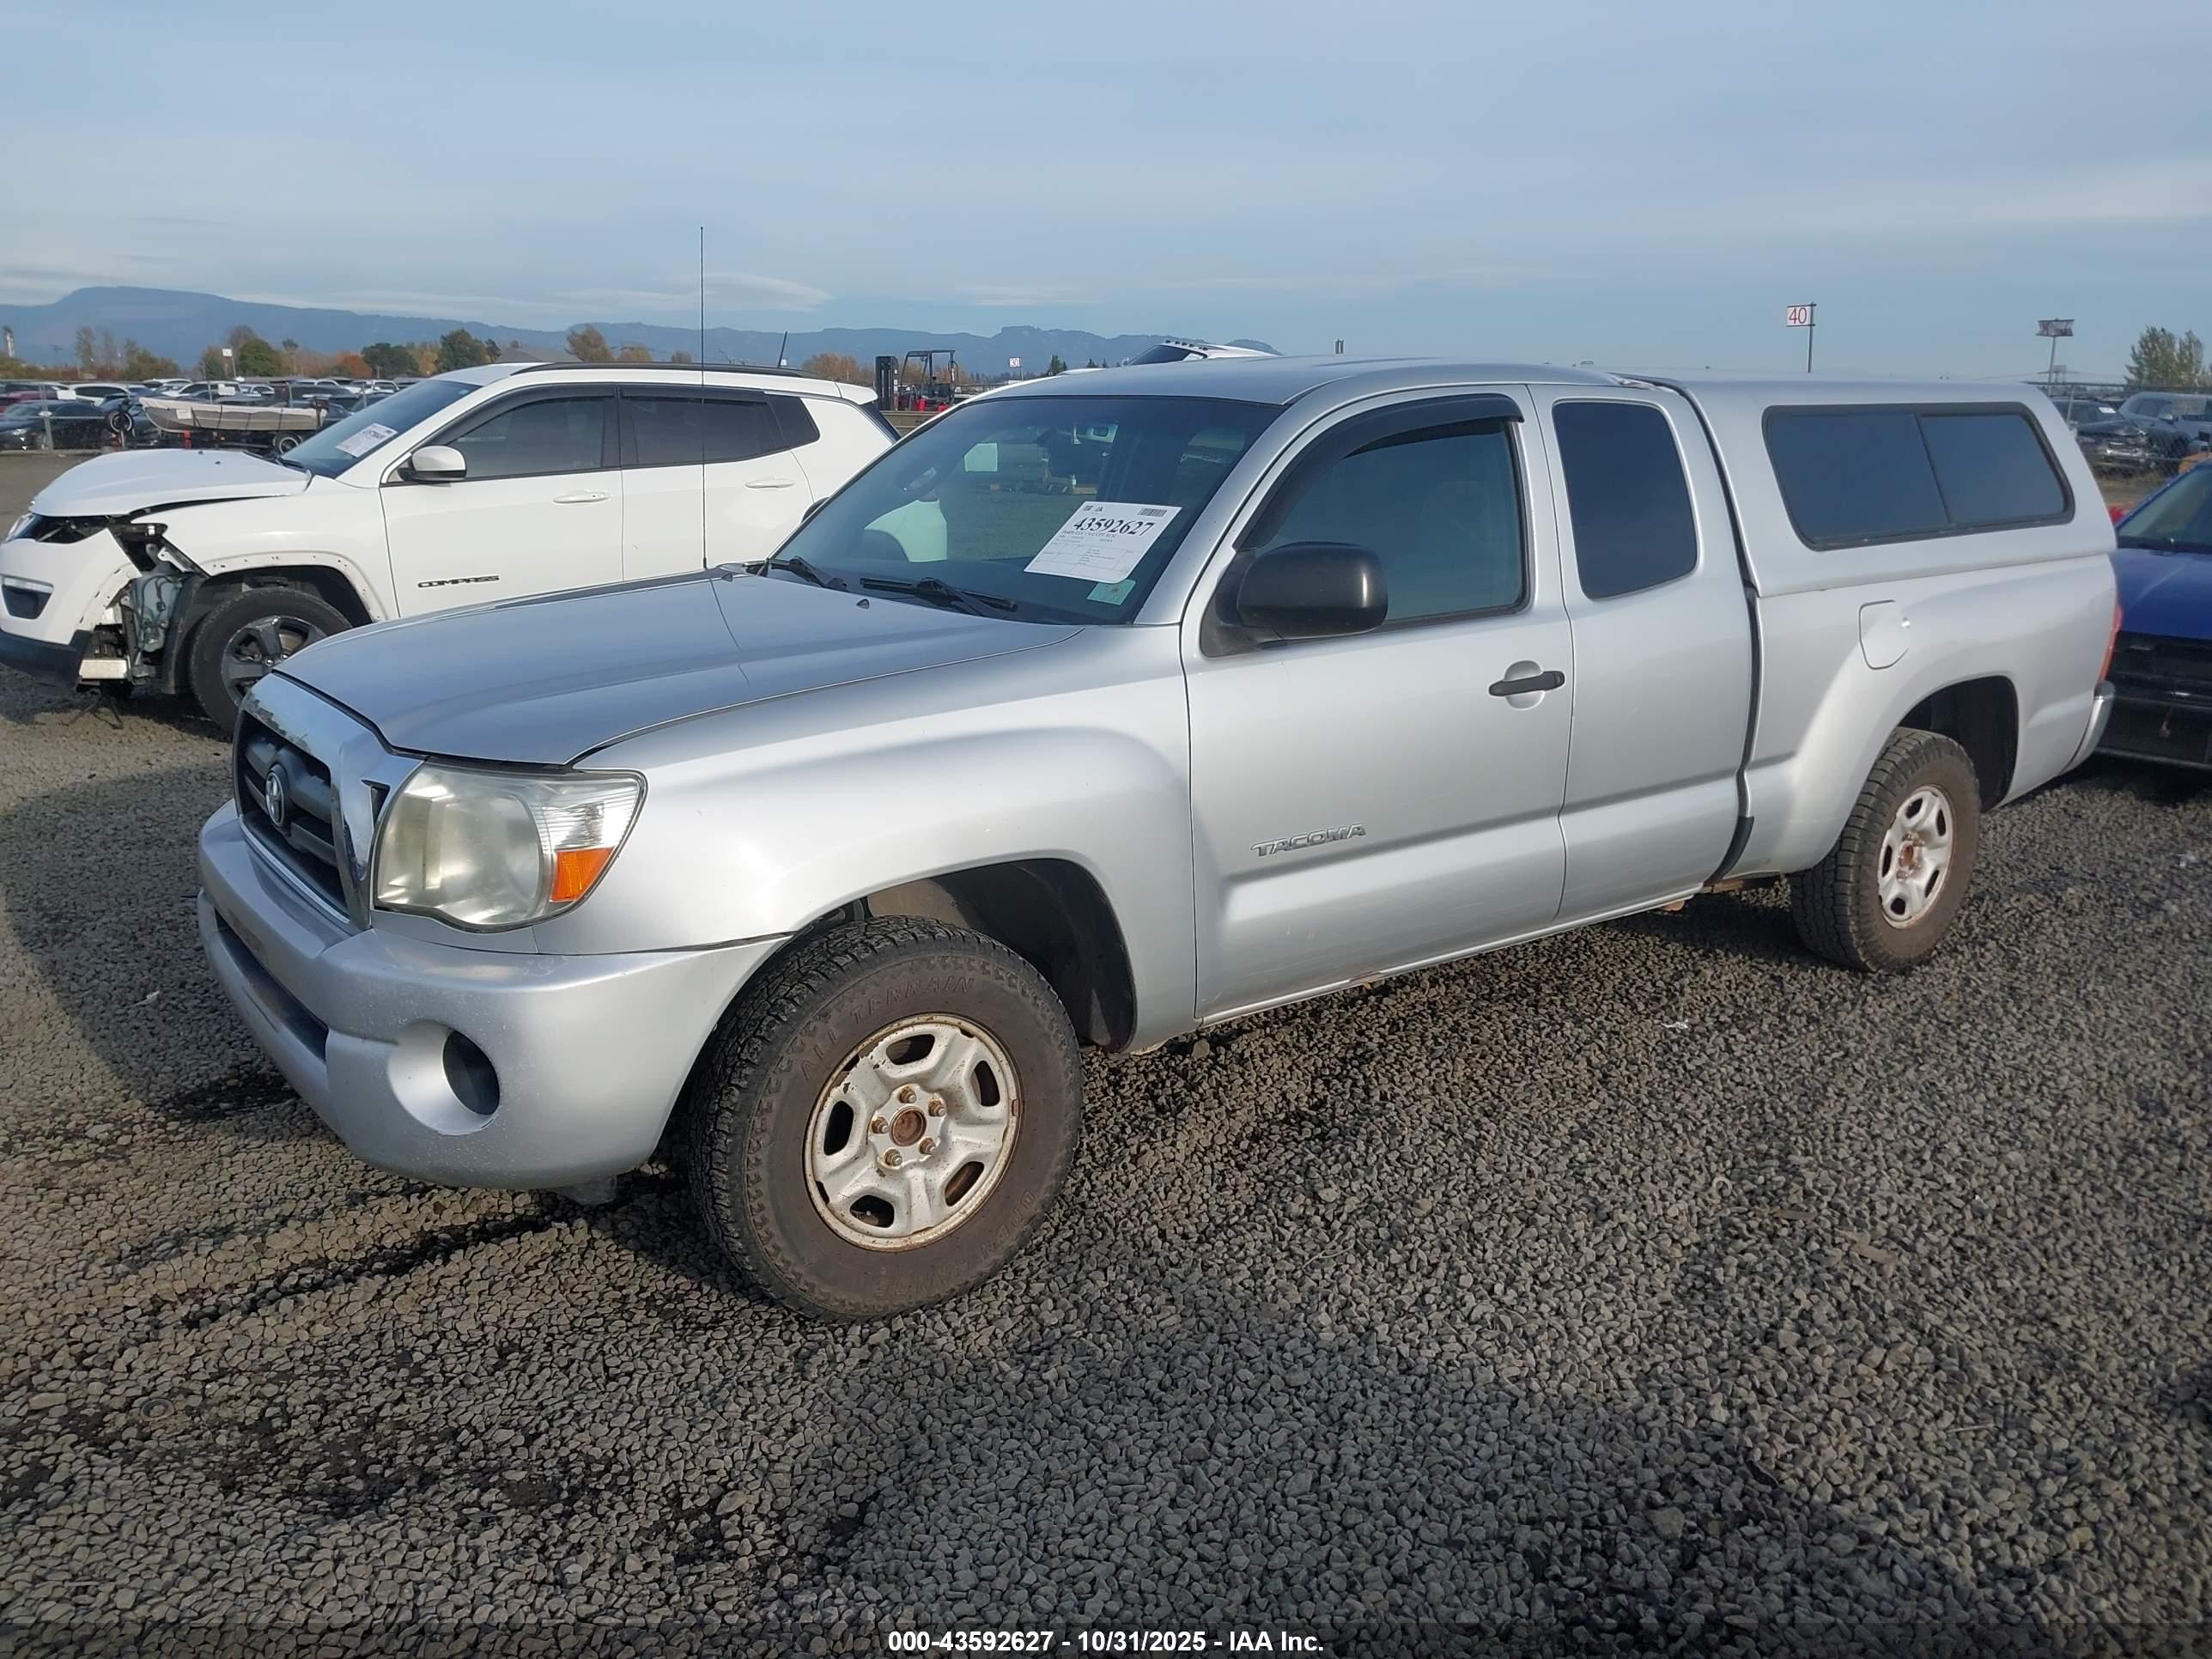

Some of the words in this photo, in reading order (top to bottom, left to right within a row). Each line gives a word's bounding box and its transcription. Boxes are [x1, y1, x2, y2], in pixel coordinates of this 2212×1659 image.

[1789, 307, 1807, 324] 40
[1073, 516, 1155, 537] 43592627
[418, 575, 500, 587] COMPASS
[1250, 823, 1366, 857] TACOMA
